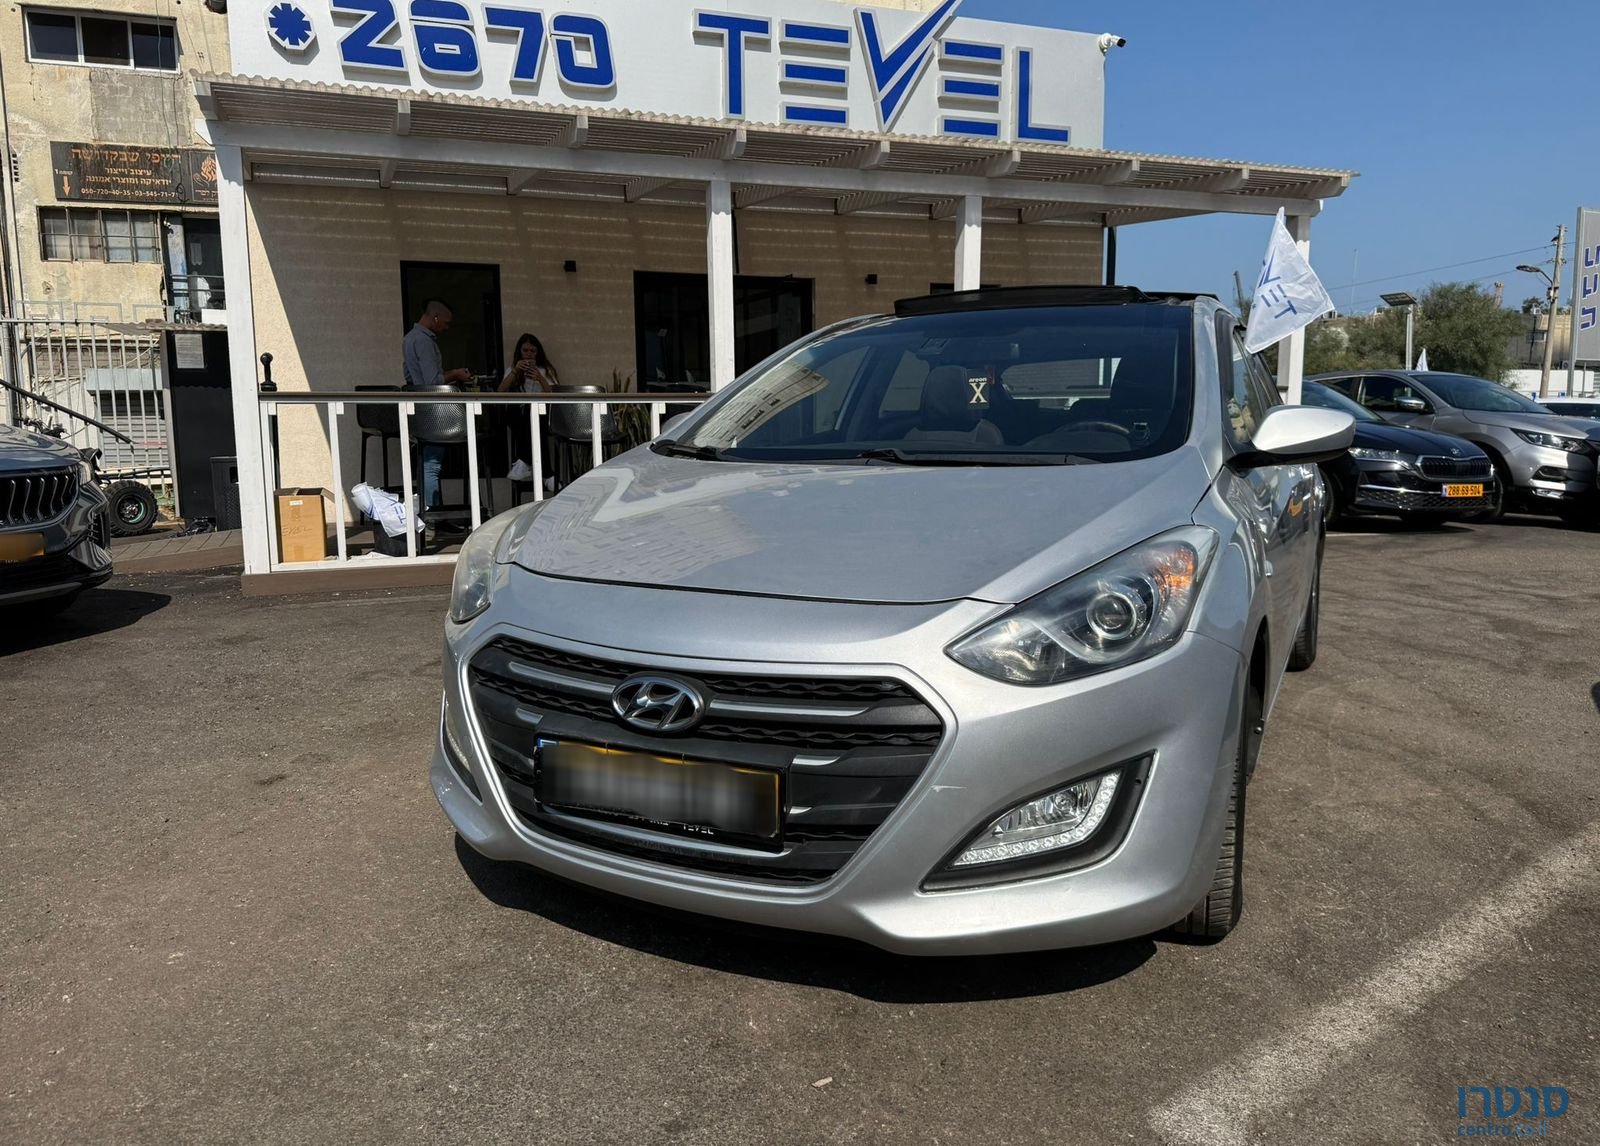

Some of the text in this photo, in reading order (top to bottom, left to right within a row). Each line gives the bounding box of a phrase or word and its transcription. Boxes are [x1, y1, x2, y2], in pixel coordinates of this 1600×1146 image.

[693, 0, 1070, 145] TEVEL
[86, 175, 111, 183] אמונה
[969, 382, 988, 404] X
